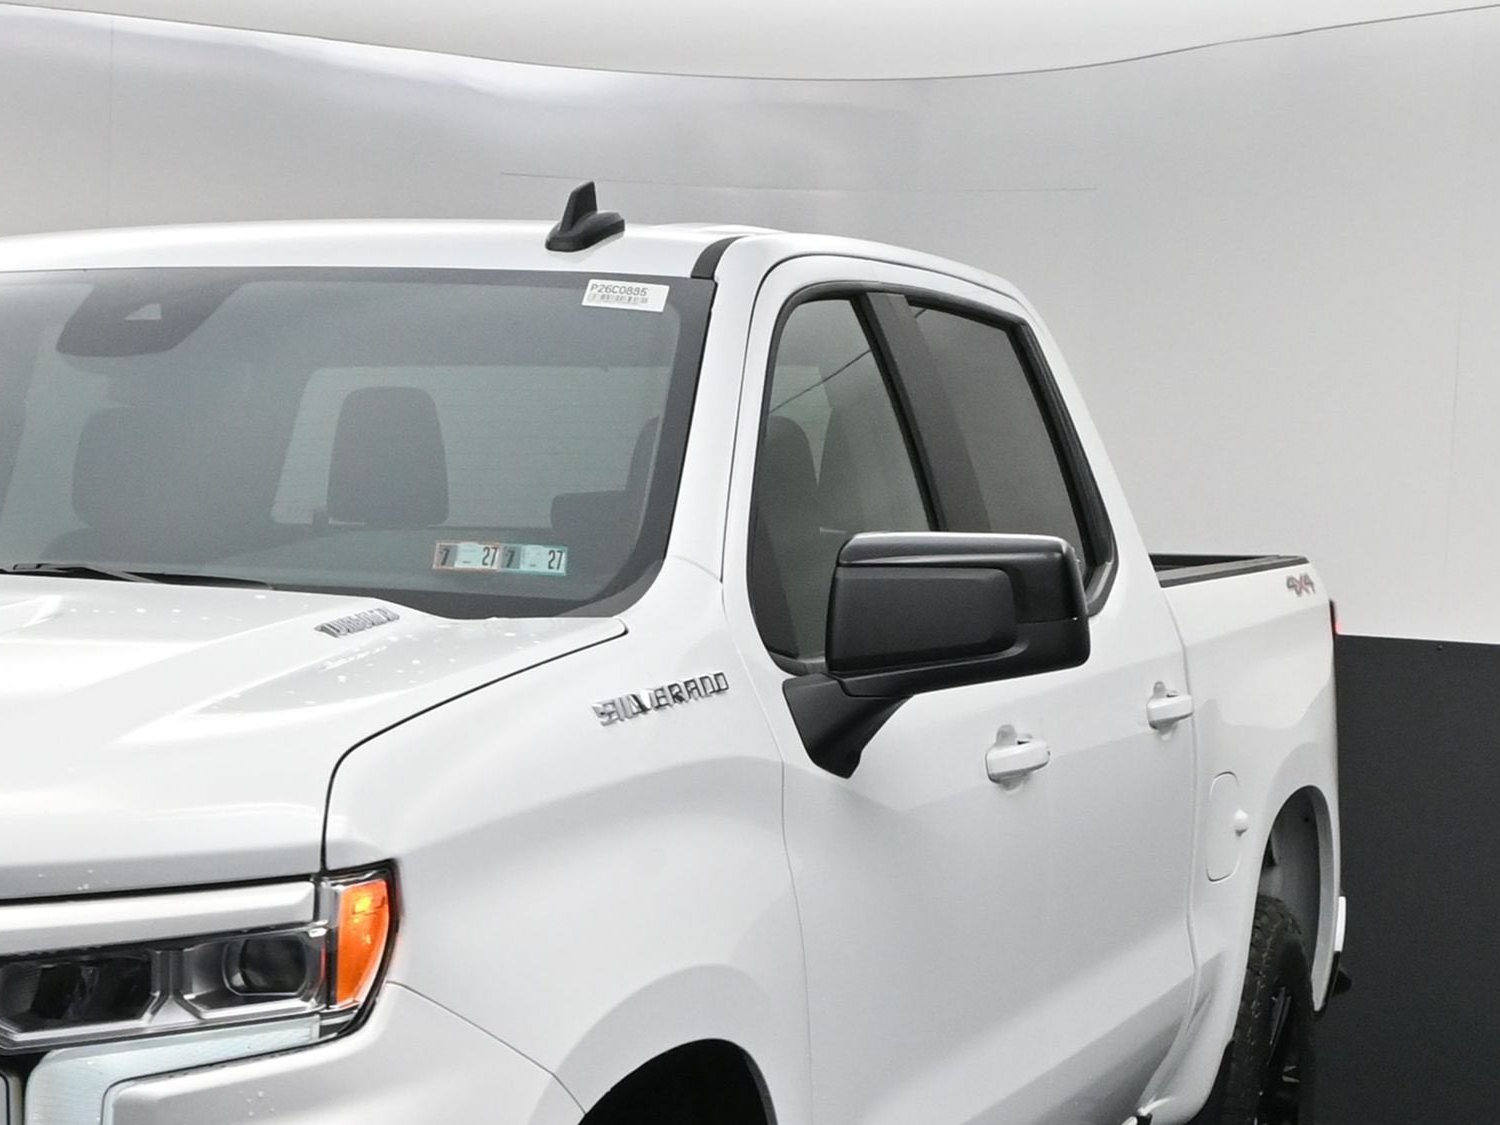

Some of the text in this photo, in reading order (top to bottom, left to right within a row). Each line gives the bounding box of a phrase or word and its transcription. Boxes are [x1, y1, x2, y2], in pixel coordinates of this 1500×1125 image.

[481, 546, 498, 568] 27
[547, 550, 563, 571] 27
[592, 671, 730, 727] SILVERADO
